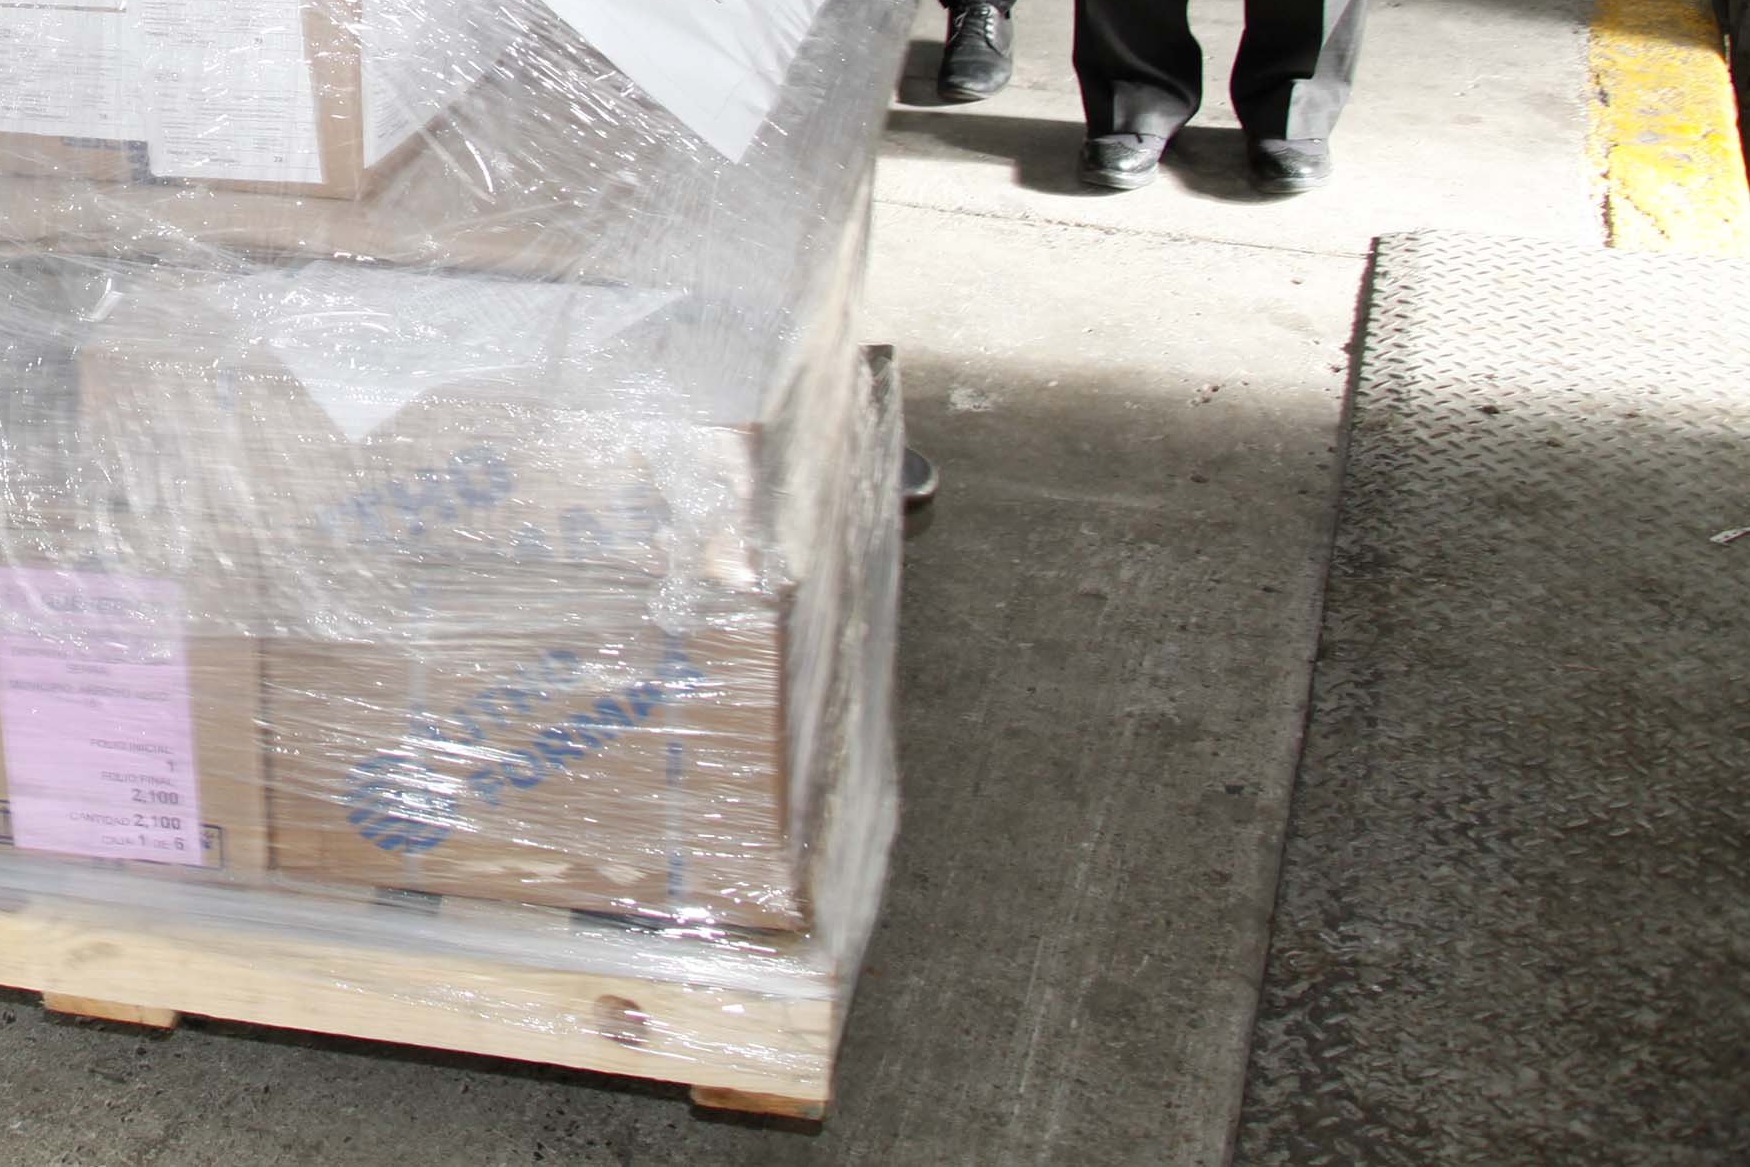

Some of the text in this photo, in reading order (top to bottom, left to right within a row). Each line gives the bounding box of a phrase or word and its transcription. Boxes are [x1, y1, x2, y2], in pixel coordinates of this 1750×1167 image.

[131, 788, 180, 805] 2,100
[133, 813, 182, 831] 2,100
[137, 834, 147, 847] 1
